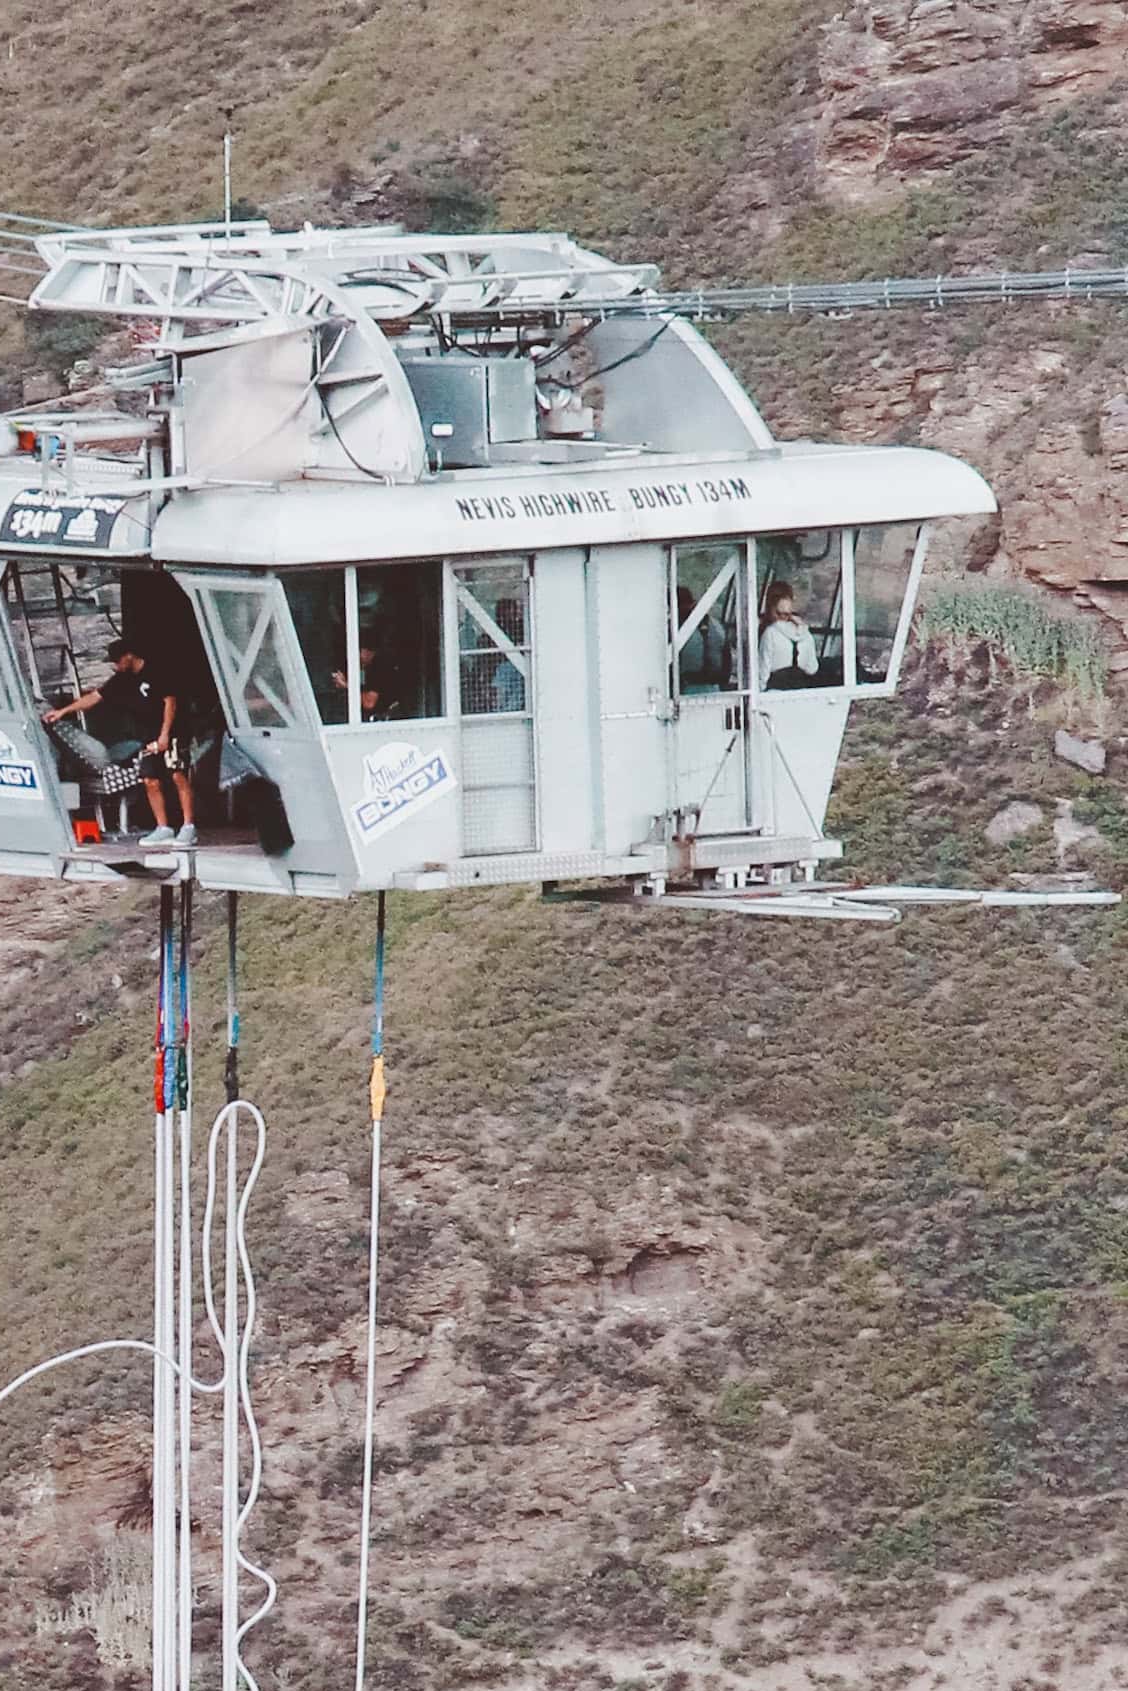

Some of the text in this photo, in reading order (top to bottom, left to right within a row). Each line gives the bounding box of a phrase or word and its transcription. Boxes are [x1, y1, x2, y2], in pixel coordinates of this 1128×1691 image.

[456, 477, 752, 520] NEVIS HIGHWIRE BUNGY 134M
[359, 759, 441, 829] BUNGY
